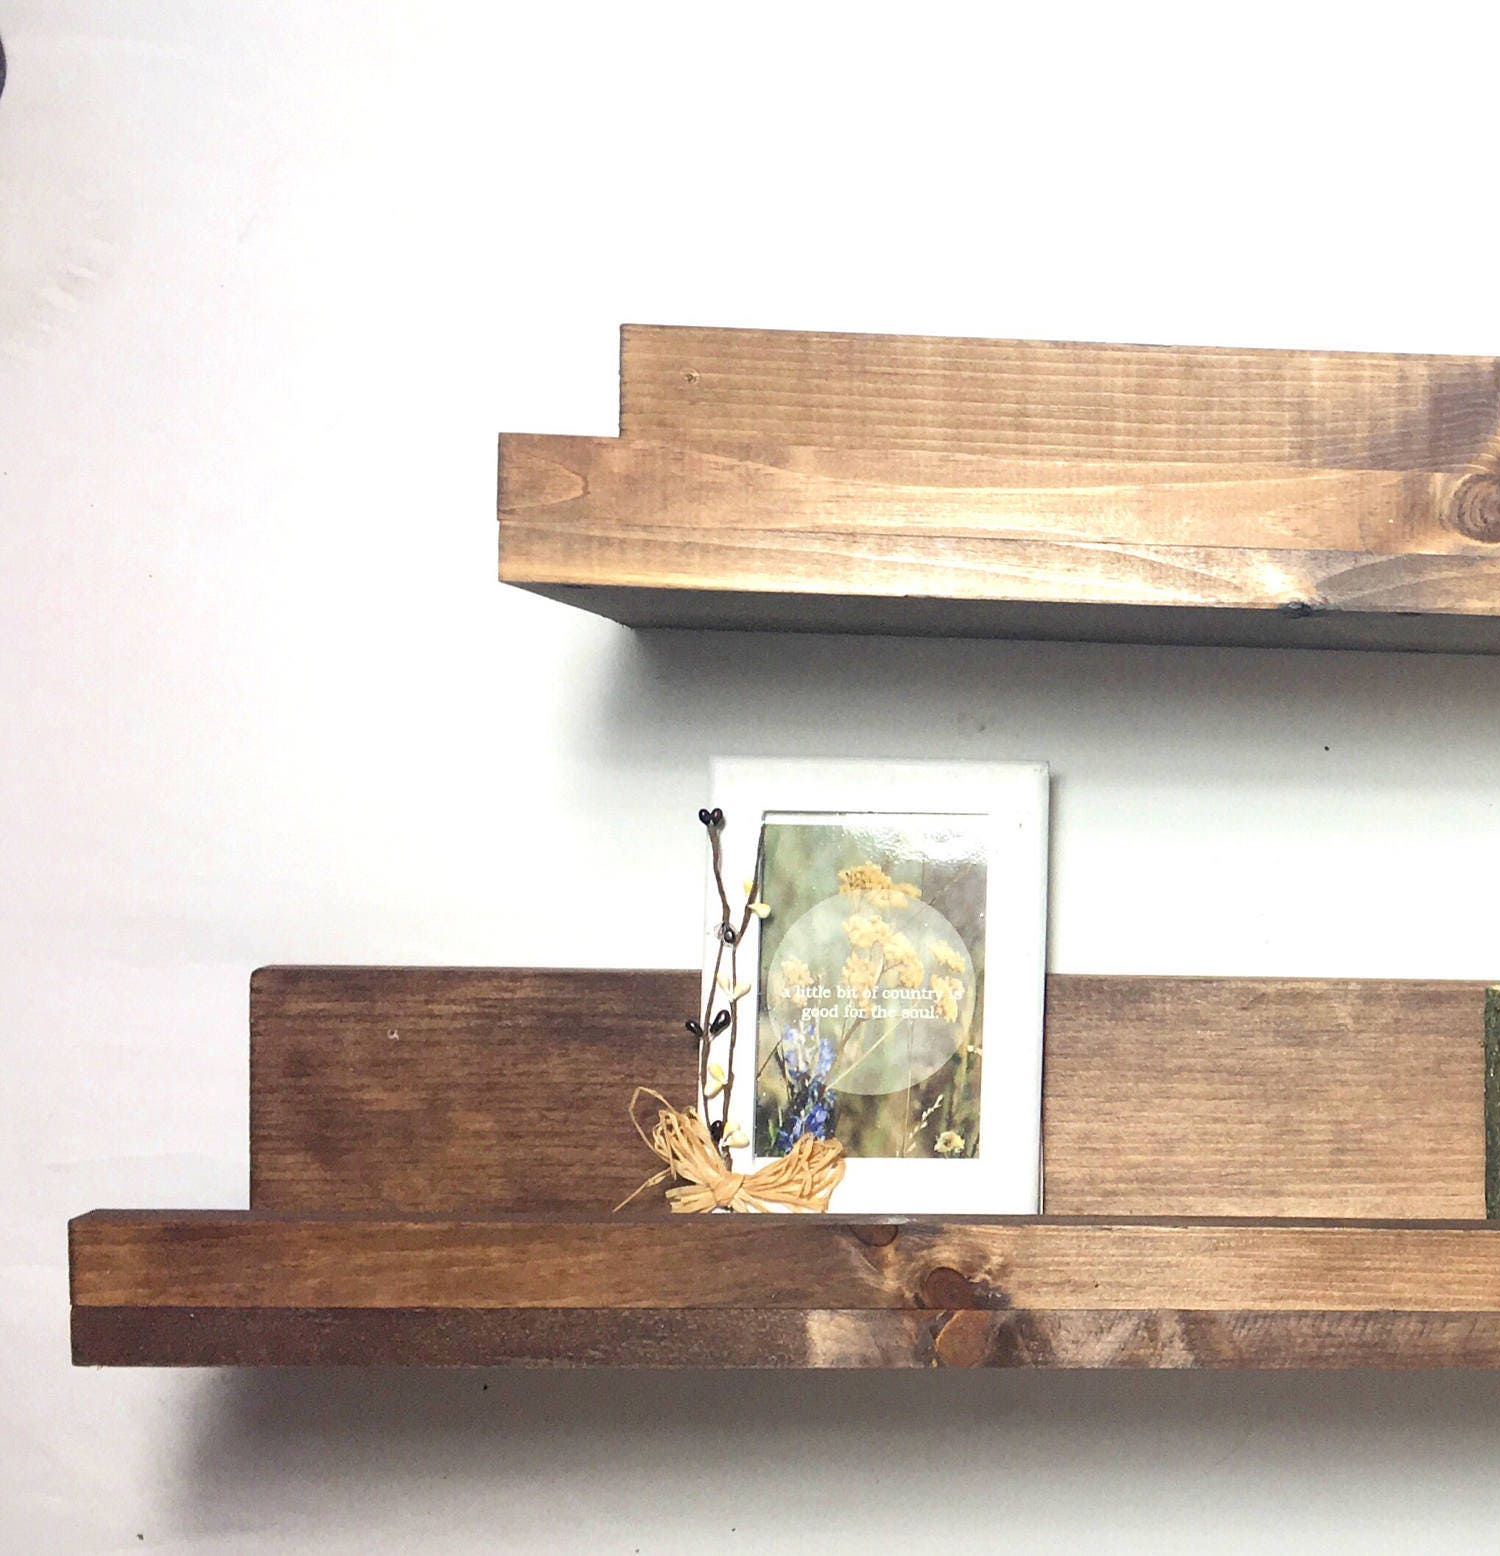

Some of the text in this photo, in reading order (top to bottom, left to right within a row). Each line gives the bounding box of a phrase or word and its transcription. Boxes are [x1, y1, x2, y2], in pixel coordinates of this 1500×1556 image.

[782, 987, 790, 998] a
[796, 987, 830, 998] little
[837, 986, 857, 998] bit
[862, 986, 879, 998] of
[882, 988, 943, 1001] country
[802, 1006, 939, 1020] good for the soul.
